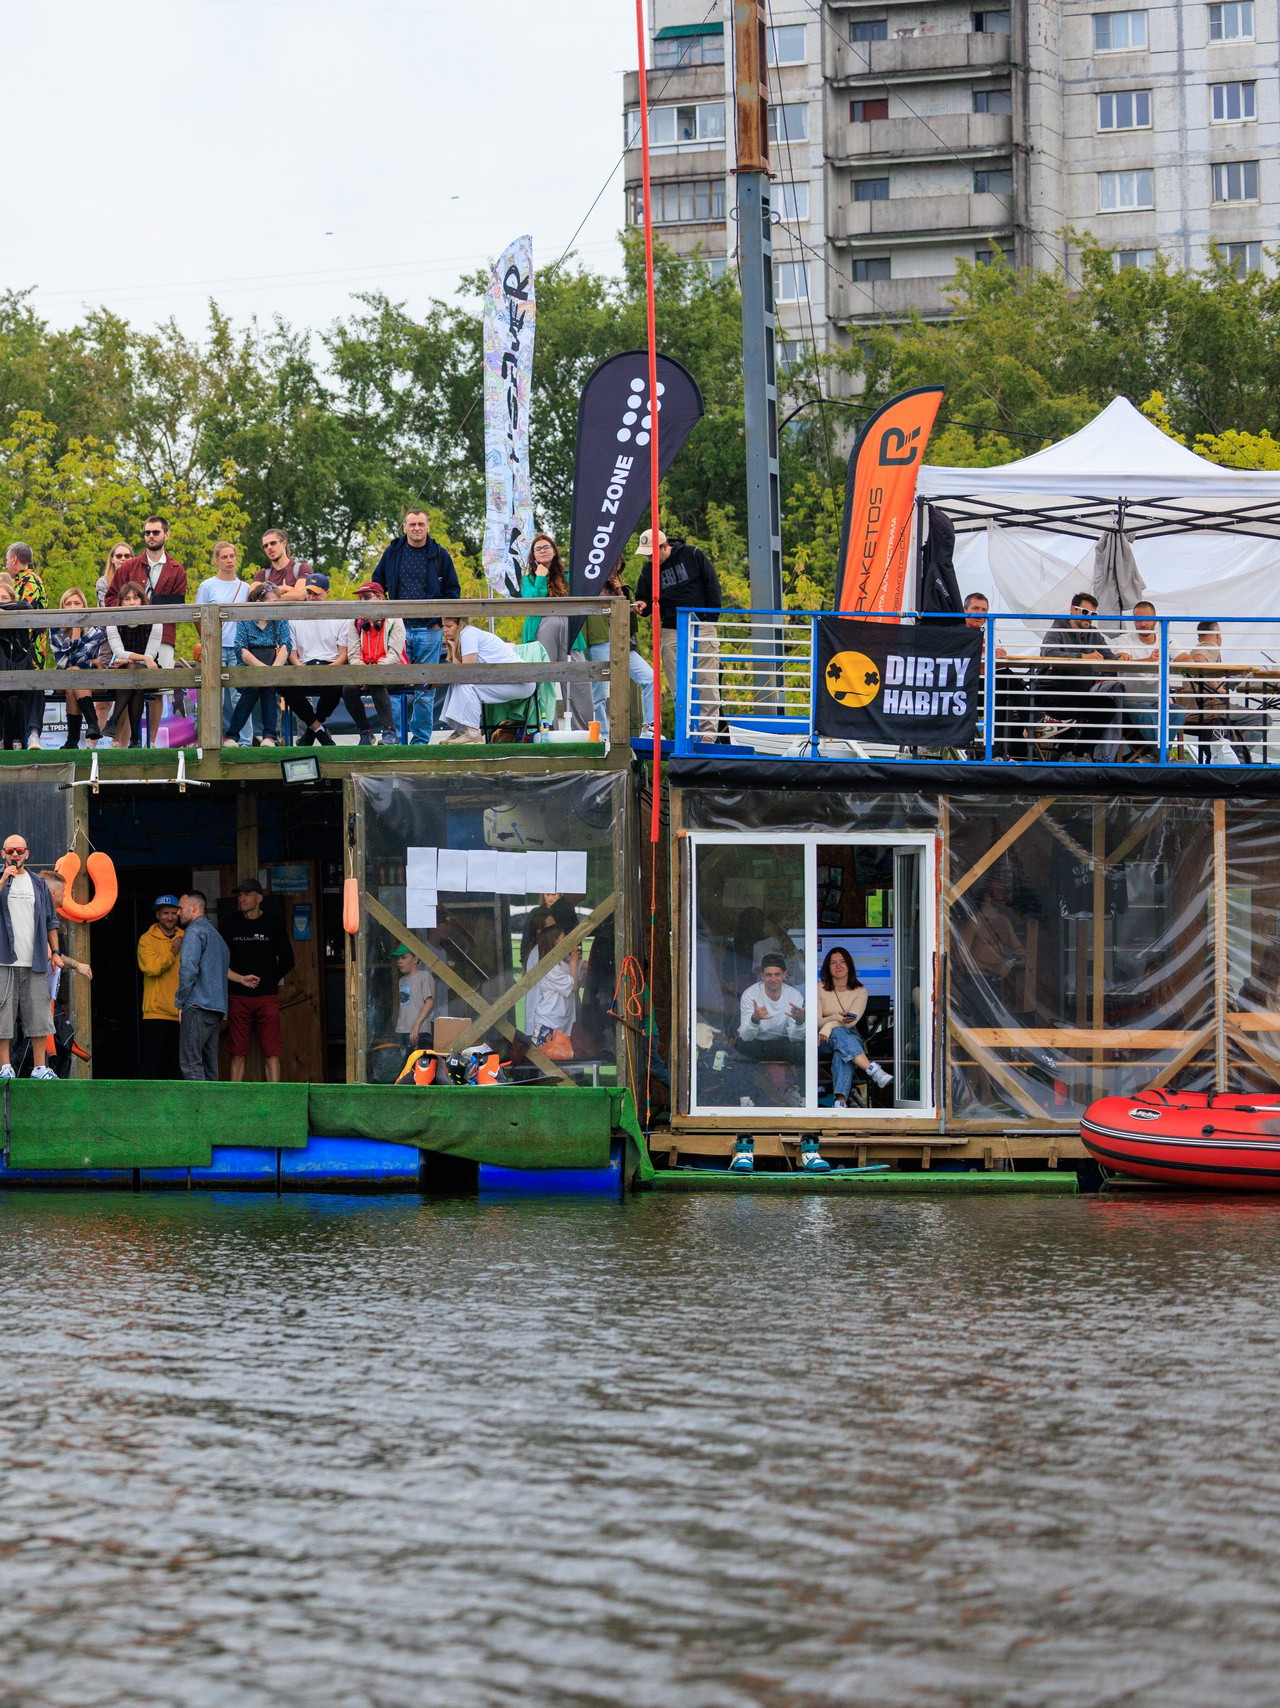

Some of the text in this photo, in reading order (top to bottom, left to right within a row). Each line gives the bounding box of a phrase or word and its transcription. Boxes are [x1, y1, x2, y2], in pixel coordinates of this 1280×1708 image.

[584, 454, 635, 580] COOL ZONE
[854, 487, 883, 613] RAKETOS
[883, 689, 967, 716] HABITS
[885, 654, 971, 687] DIRTY
